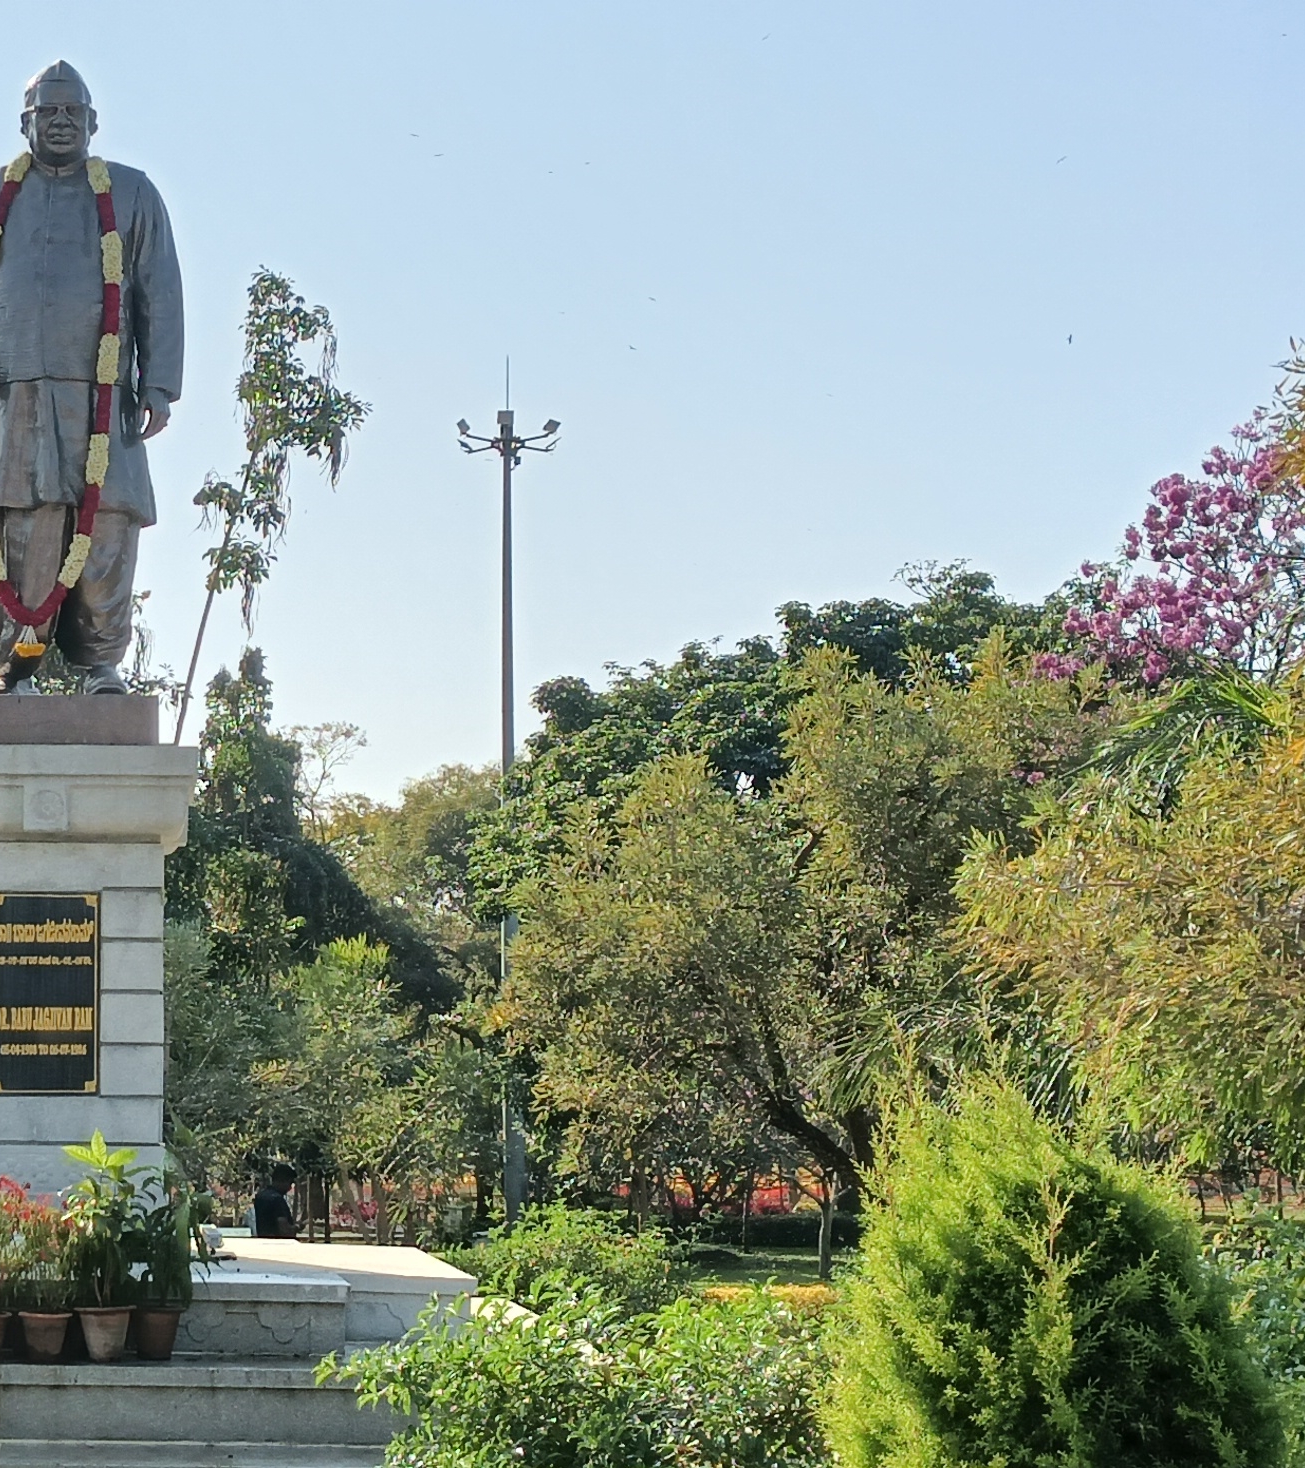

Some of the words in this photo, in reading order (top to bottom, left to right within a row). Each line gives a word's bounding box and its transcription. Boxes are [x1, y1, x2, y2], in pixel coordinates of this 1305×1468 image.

[11, 1007, 33, 1030] BABU
[74, 1007, 93, 1030] RAM
[38, 1044, 49, 1055] TO
